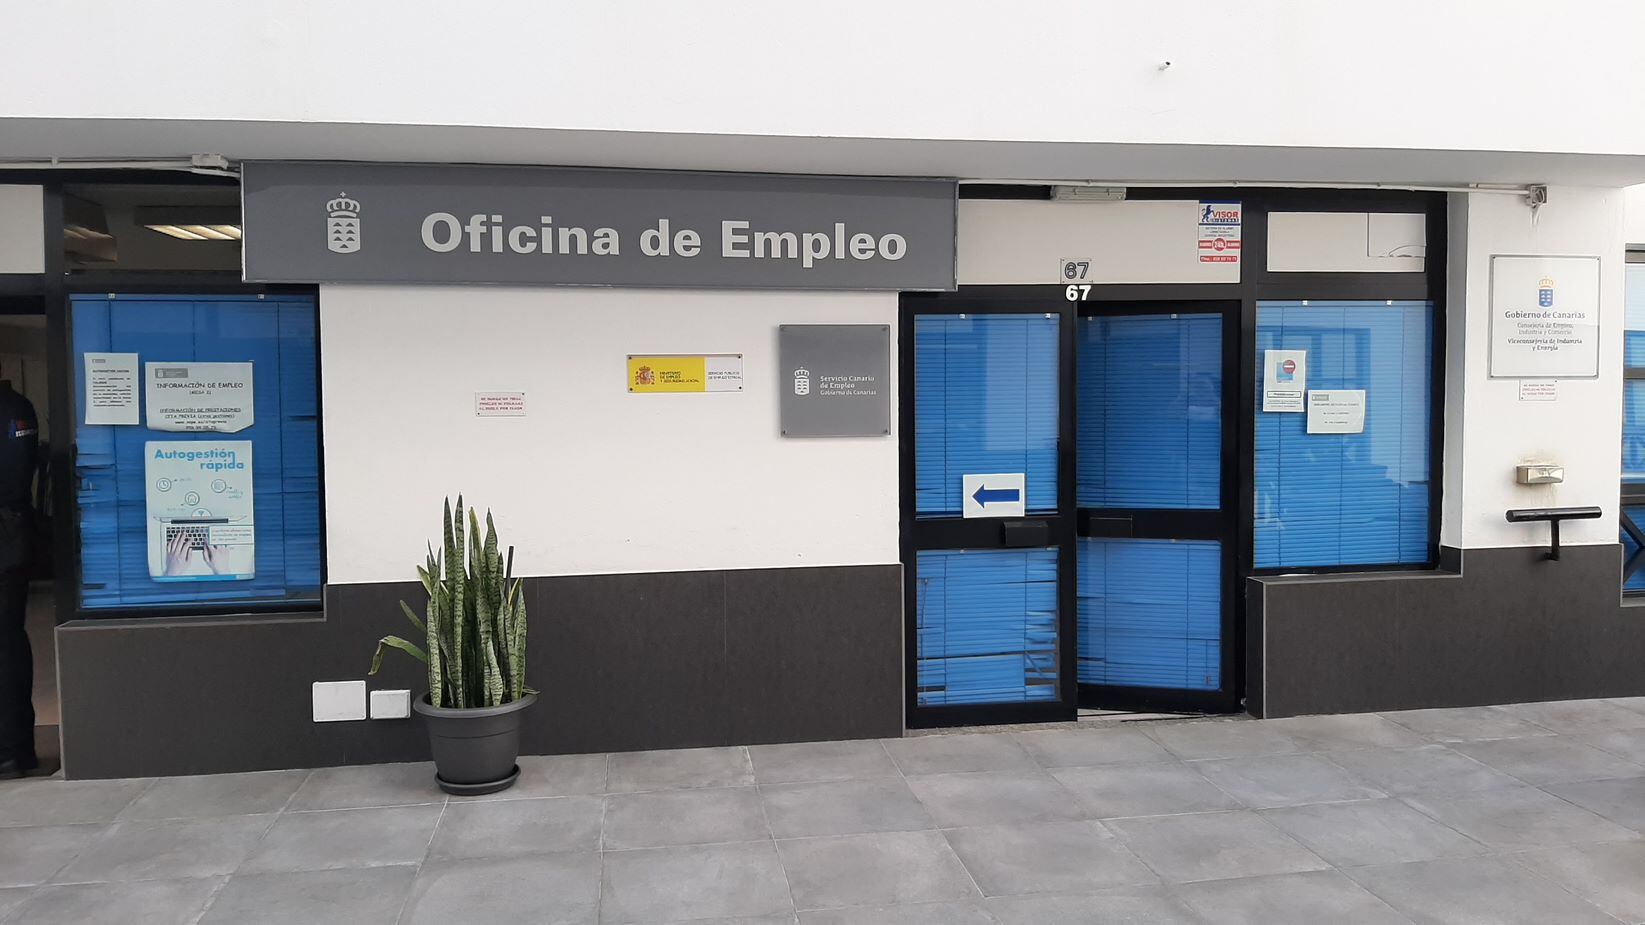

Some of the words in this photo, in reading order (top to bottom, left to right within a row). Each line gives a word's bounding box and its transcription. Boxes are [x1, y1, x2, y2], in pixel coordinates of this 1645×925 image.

[420, 211, 620, 256] Oficina
[639, 218, 702, 258] de
[721, 219, 907, 269] Empleo
[1064, 261, 1089, 280] 67
[1065, 284, 1092, 302] 67
[1505, 310, 1541, 319] Gobierno
[1542, 311, 1552, 319] de
[1552, 311, 1586, 319] Canarias
[156, 381, 205, 389] INFORMACIÓN
[829, 382, 856, 390] Empleo
[154, 448, 236, 462] Autogestión
[199, 459, 244, 472] rápida
